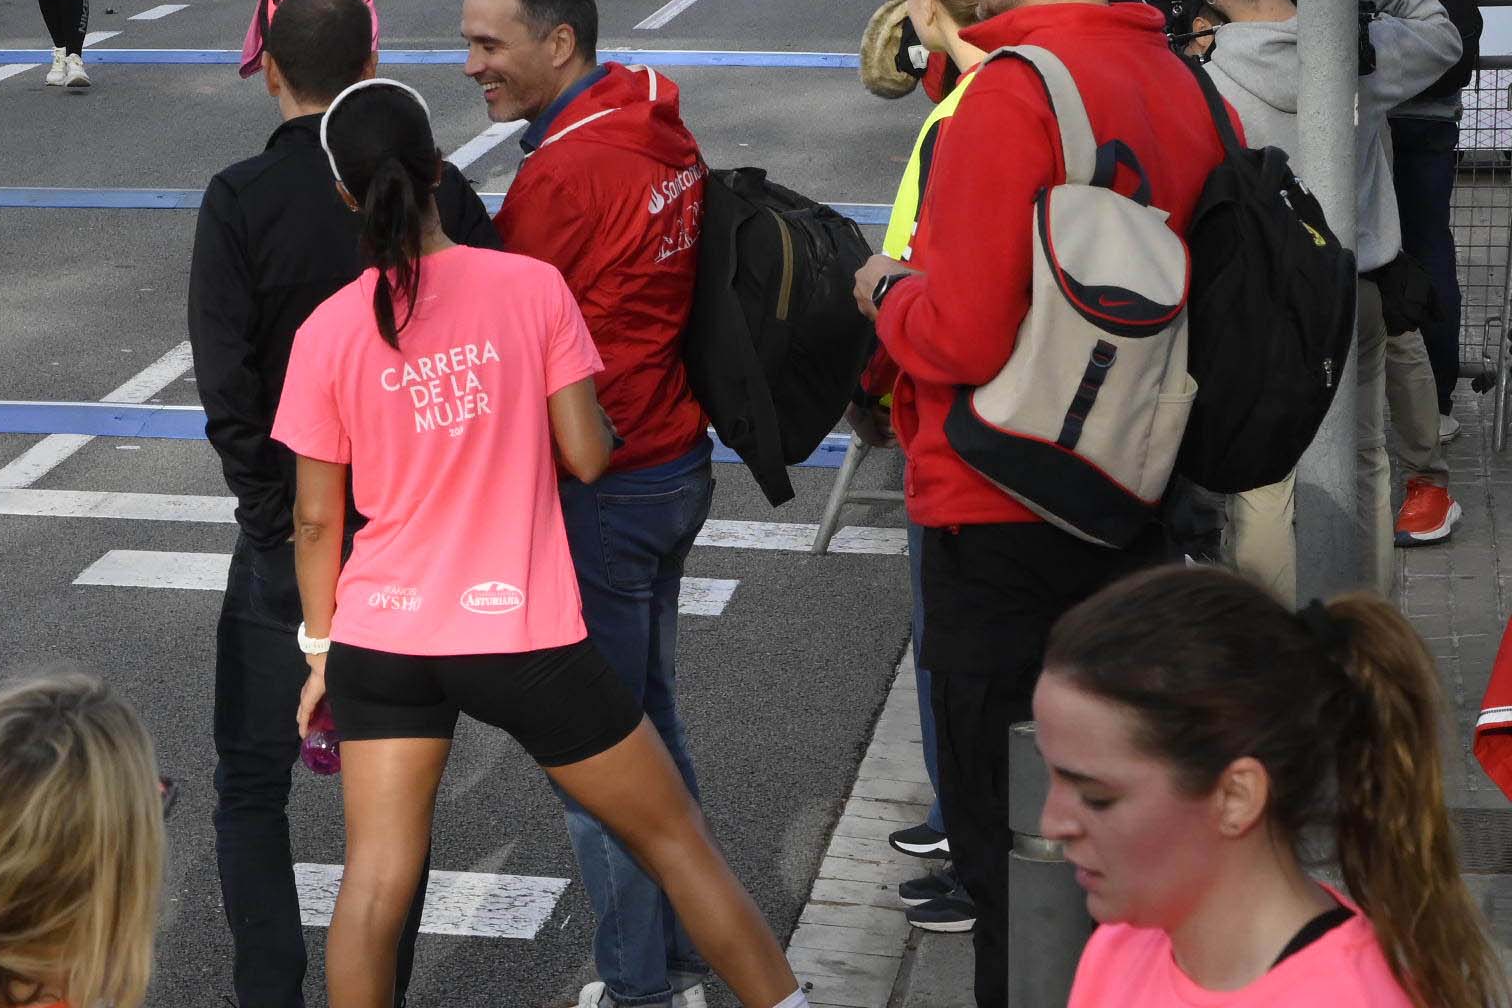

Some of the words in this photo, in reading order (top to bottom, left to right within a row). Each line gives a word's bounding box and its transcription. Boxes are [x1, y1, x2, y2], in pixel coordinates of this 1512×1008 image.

[381, 339, 501, 393] CARRERA
[409, 380, 444, 409] DE
[451, 371, 482, 398] LA
[414, 392, 493, 433] MUJER
